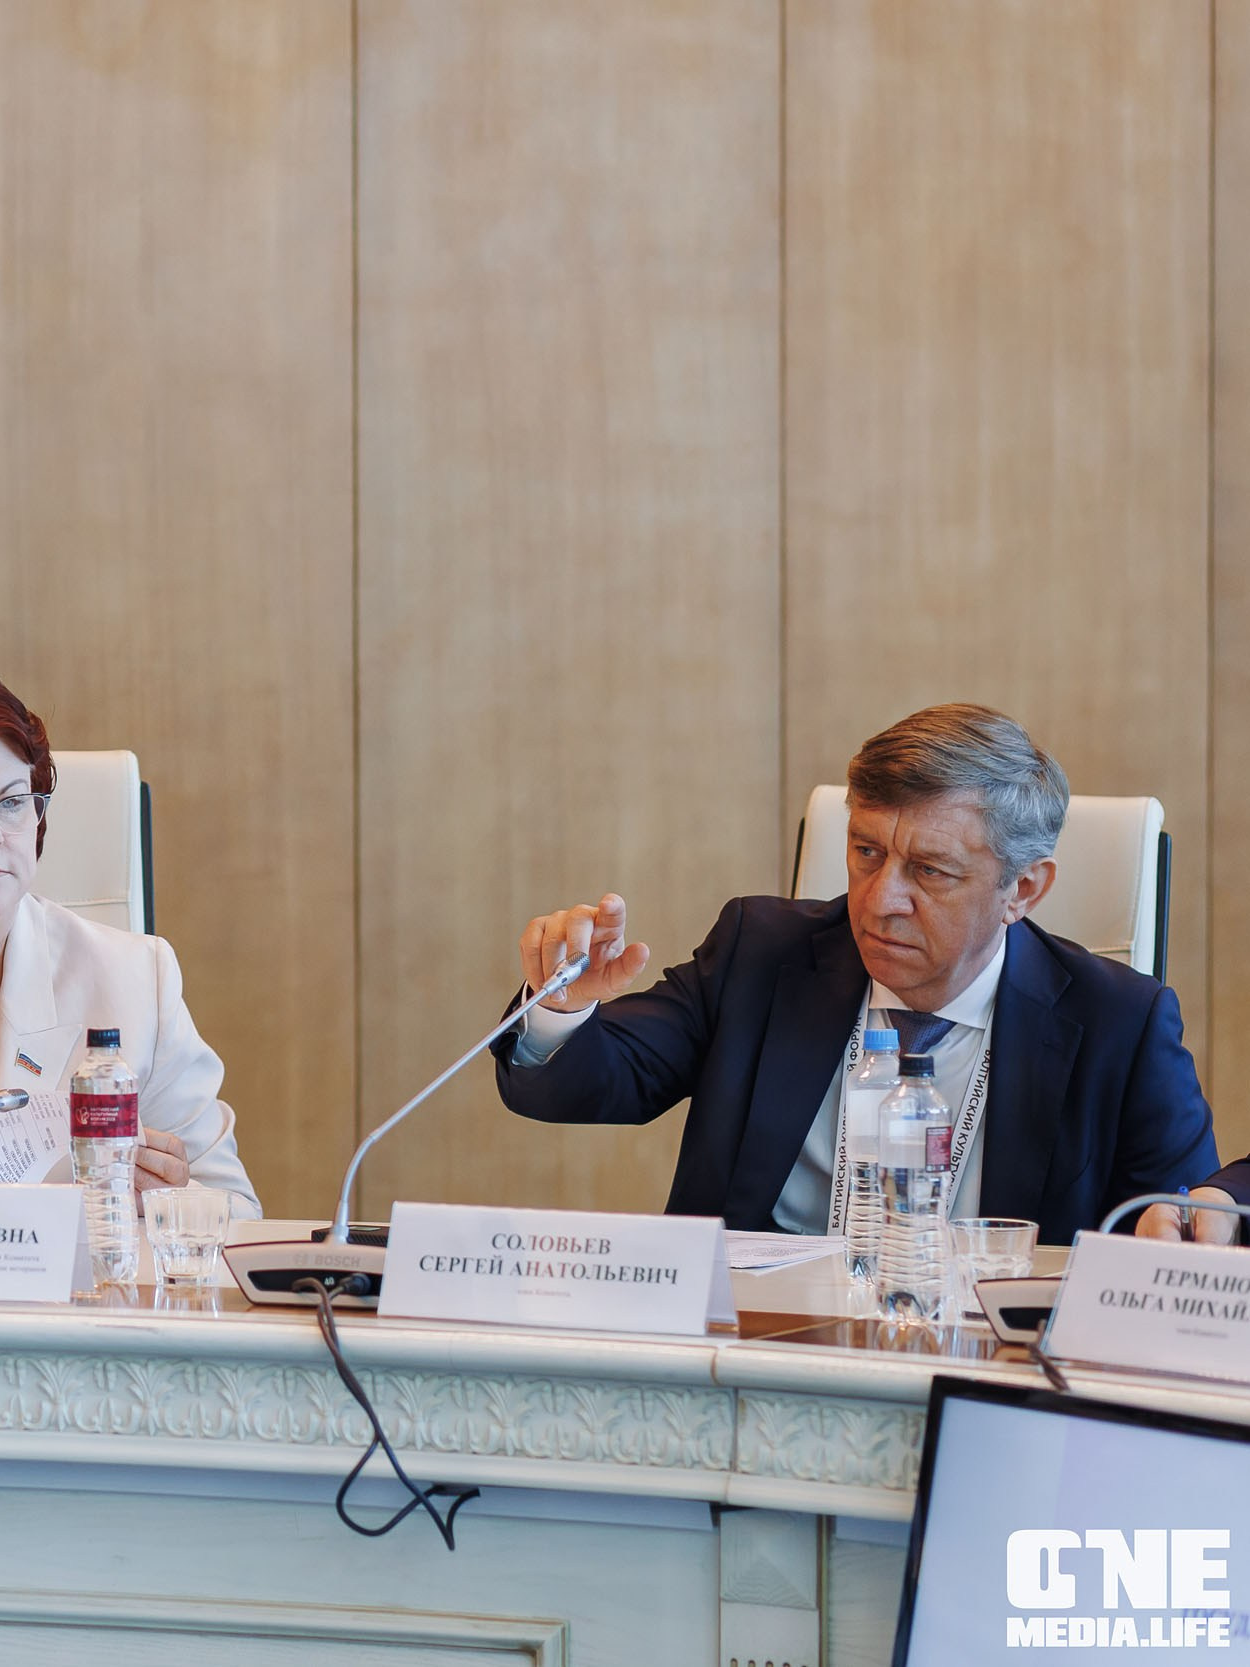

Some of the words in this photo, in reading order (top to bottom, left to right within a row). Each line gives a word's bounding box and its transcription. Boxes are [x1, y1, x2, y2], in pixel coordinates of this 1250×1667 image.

[832, 1145, 847, 1229] БАЛТИЙСКИЙ
[490, 1232, 611, 1255] СОЛОВЬЕВ
[418, 1254, 504, 1276] СЕРГЕЙ
[509, 1260, 679, 1285] АНАТОЛЬЕВИЧ
[1153, 1267, 1250, 1294] ГЕРМАНО
[1100, 1288, 1164, 1312] ОЛЬГА
[1171, 1296, 1250, 1321] МИХАЙ
